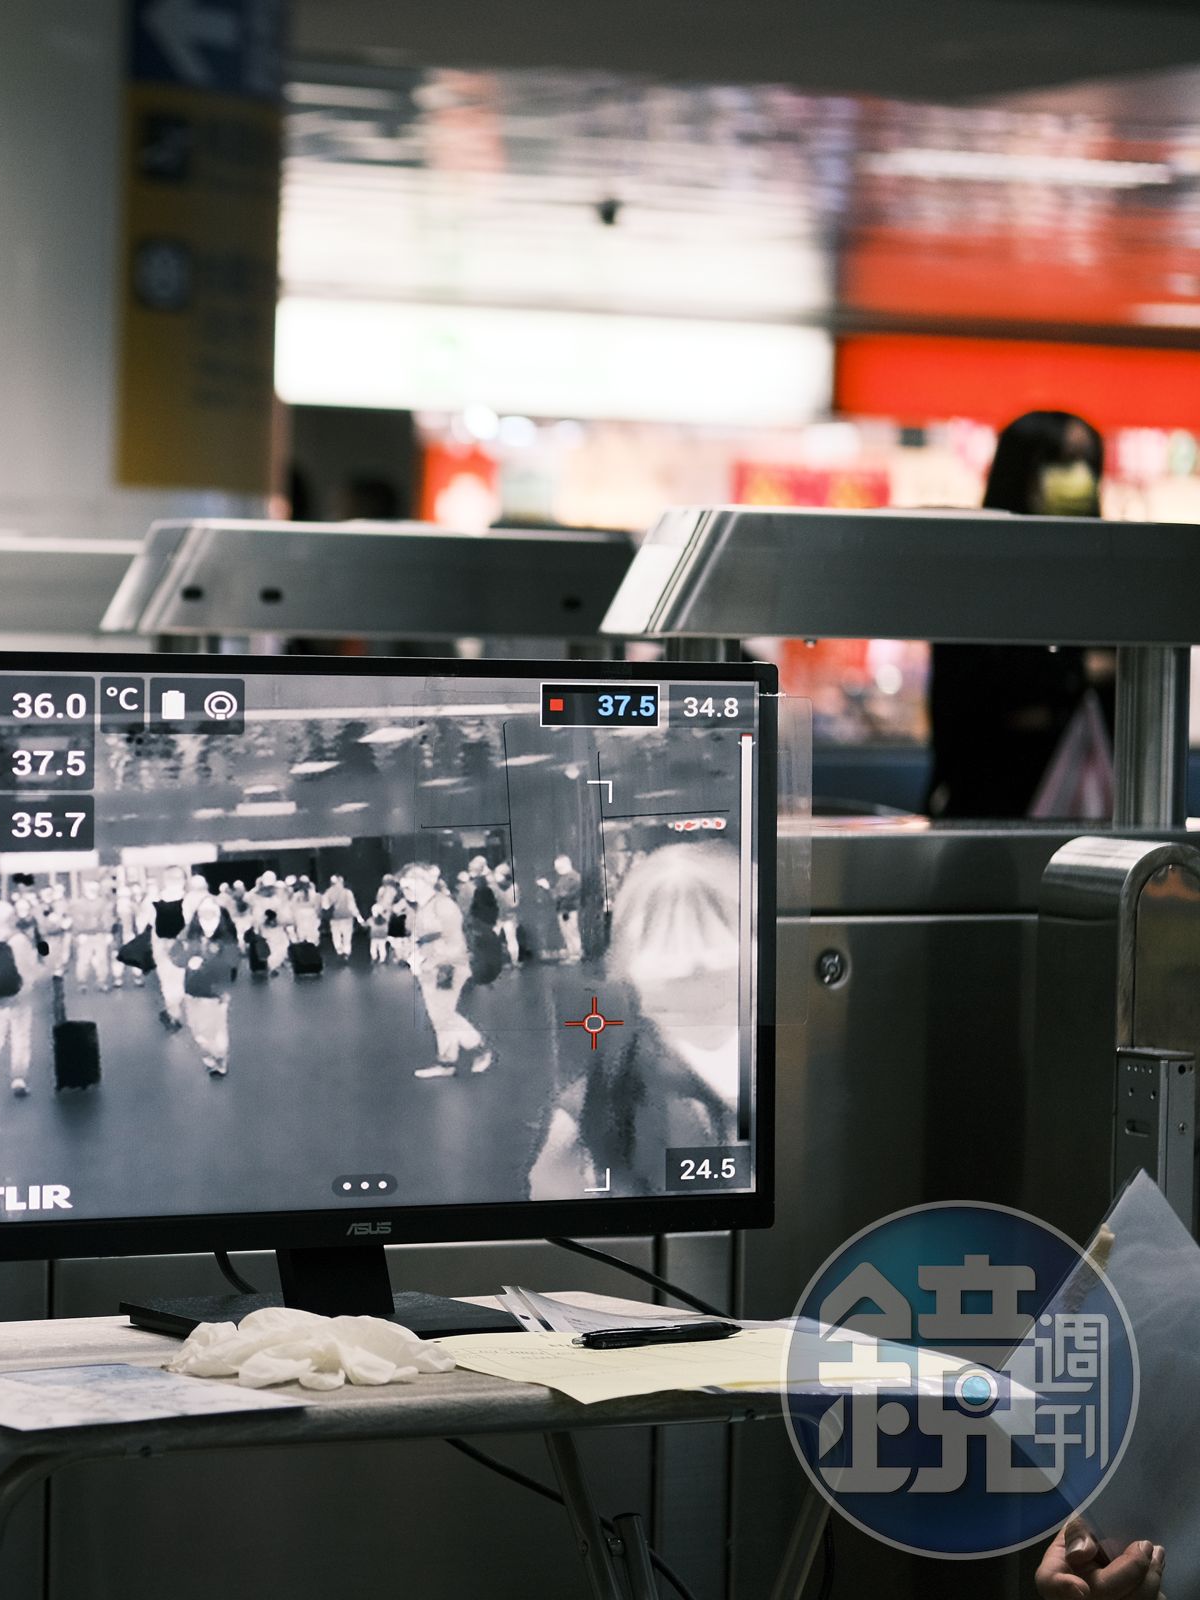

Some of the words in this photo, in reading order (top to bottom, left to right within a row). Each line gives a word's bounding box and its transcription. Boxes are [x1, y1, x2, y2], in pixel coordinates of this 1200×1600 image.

[11, 692, 87, 719] 36.0
[597, 694, 656, 717] 37.5
[683, 696, 740, 718] 34.8
[11, 750, 87, 776] 37.5
[11, 812, 87, 838] 35.7
[680, 1157, 736, 1180] 24.5
[345, 1221, 392, 1236] ASUS
